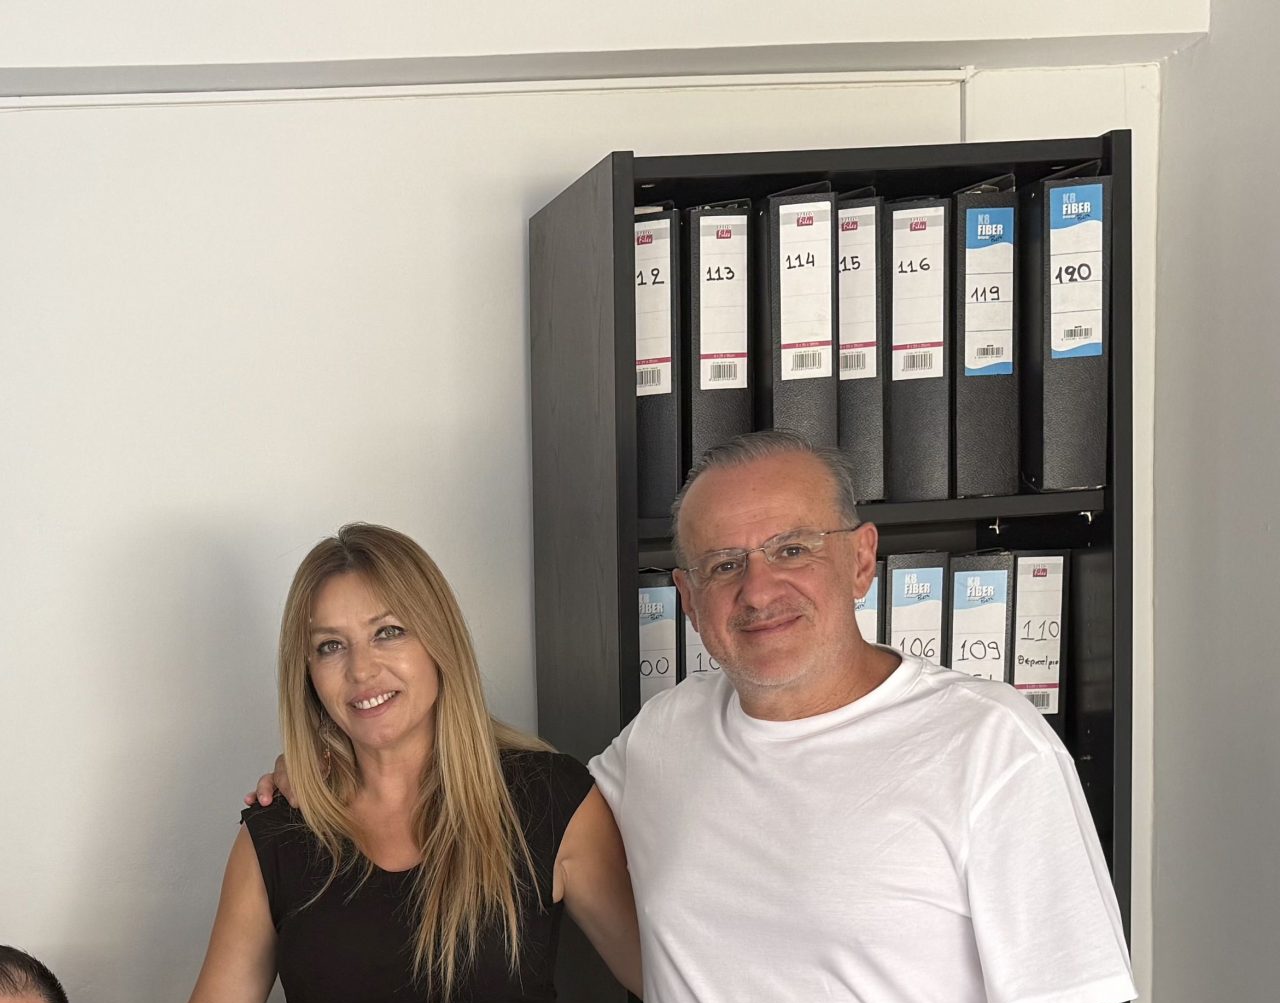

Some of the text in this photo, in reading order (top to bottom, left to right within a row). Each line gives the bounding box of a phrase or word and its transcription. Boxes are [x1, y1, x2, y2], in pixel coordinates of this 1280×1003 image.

[1063, 202, 1091, 215] FIBER
[978, 224, 1004, 236] FIBER
[785, 252, 815, 269] 114
[839, 256, 861, 273] 15
[898, 257, 931, 274] 116
[706, 266, 735, 281] 113
[1055, 263, 1092, 284] 120
[971, 286, 1000, 302] 119
[905, 583, 931, 594] FIBER
[967, 586, 994, 597] FIBER
[1021, 620, 1059, 642] 110
[900, 637, 936, 657] 106
[957, 640, 1001, 661] 109
